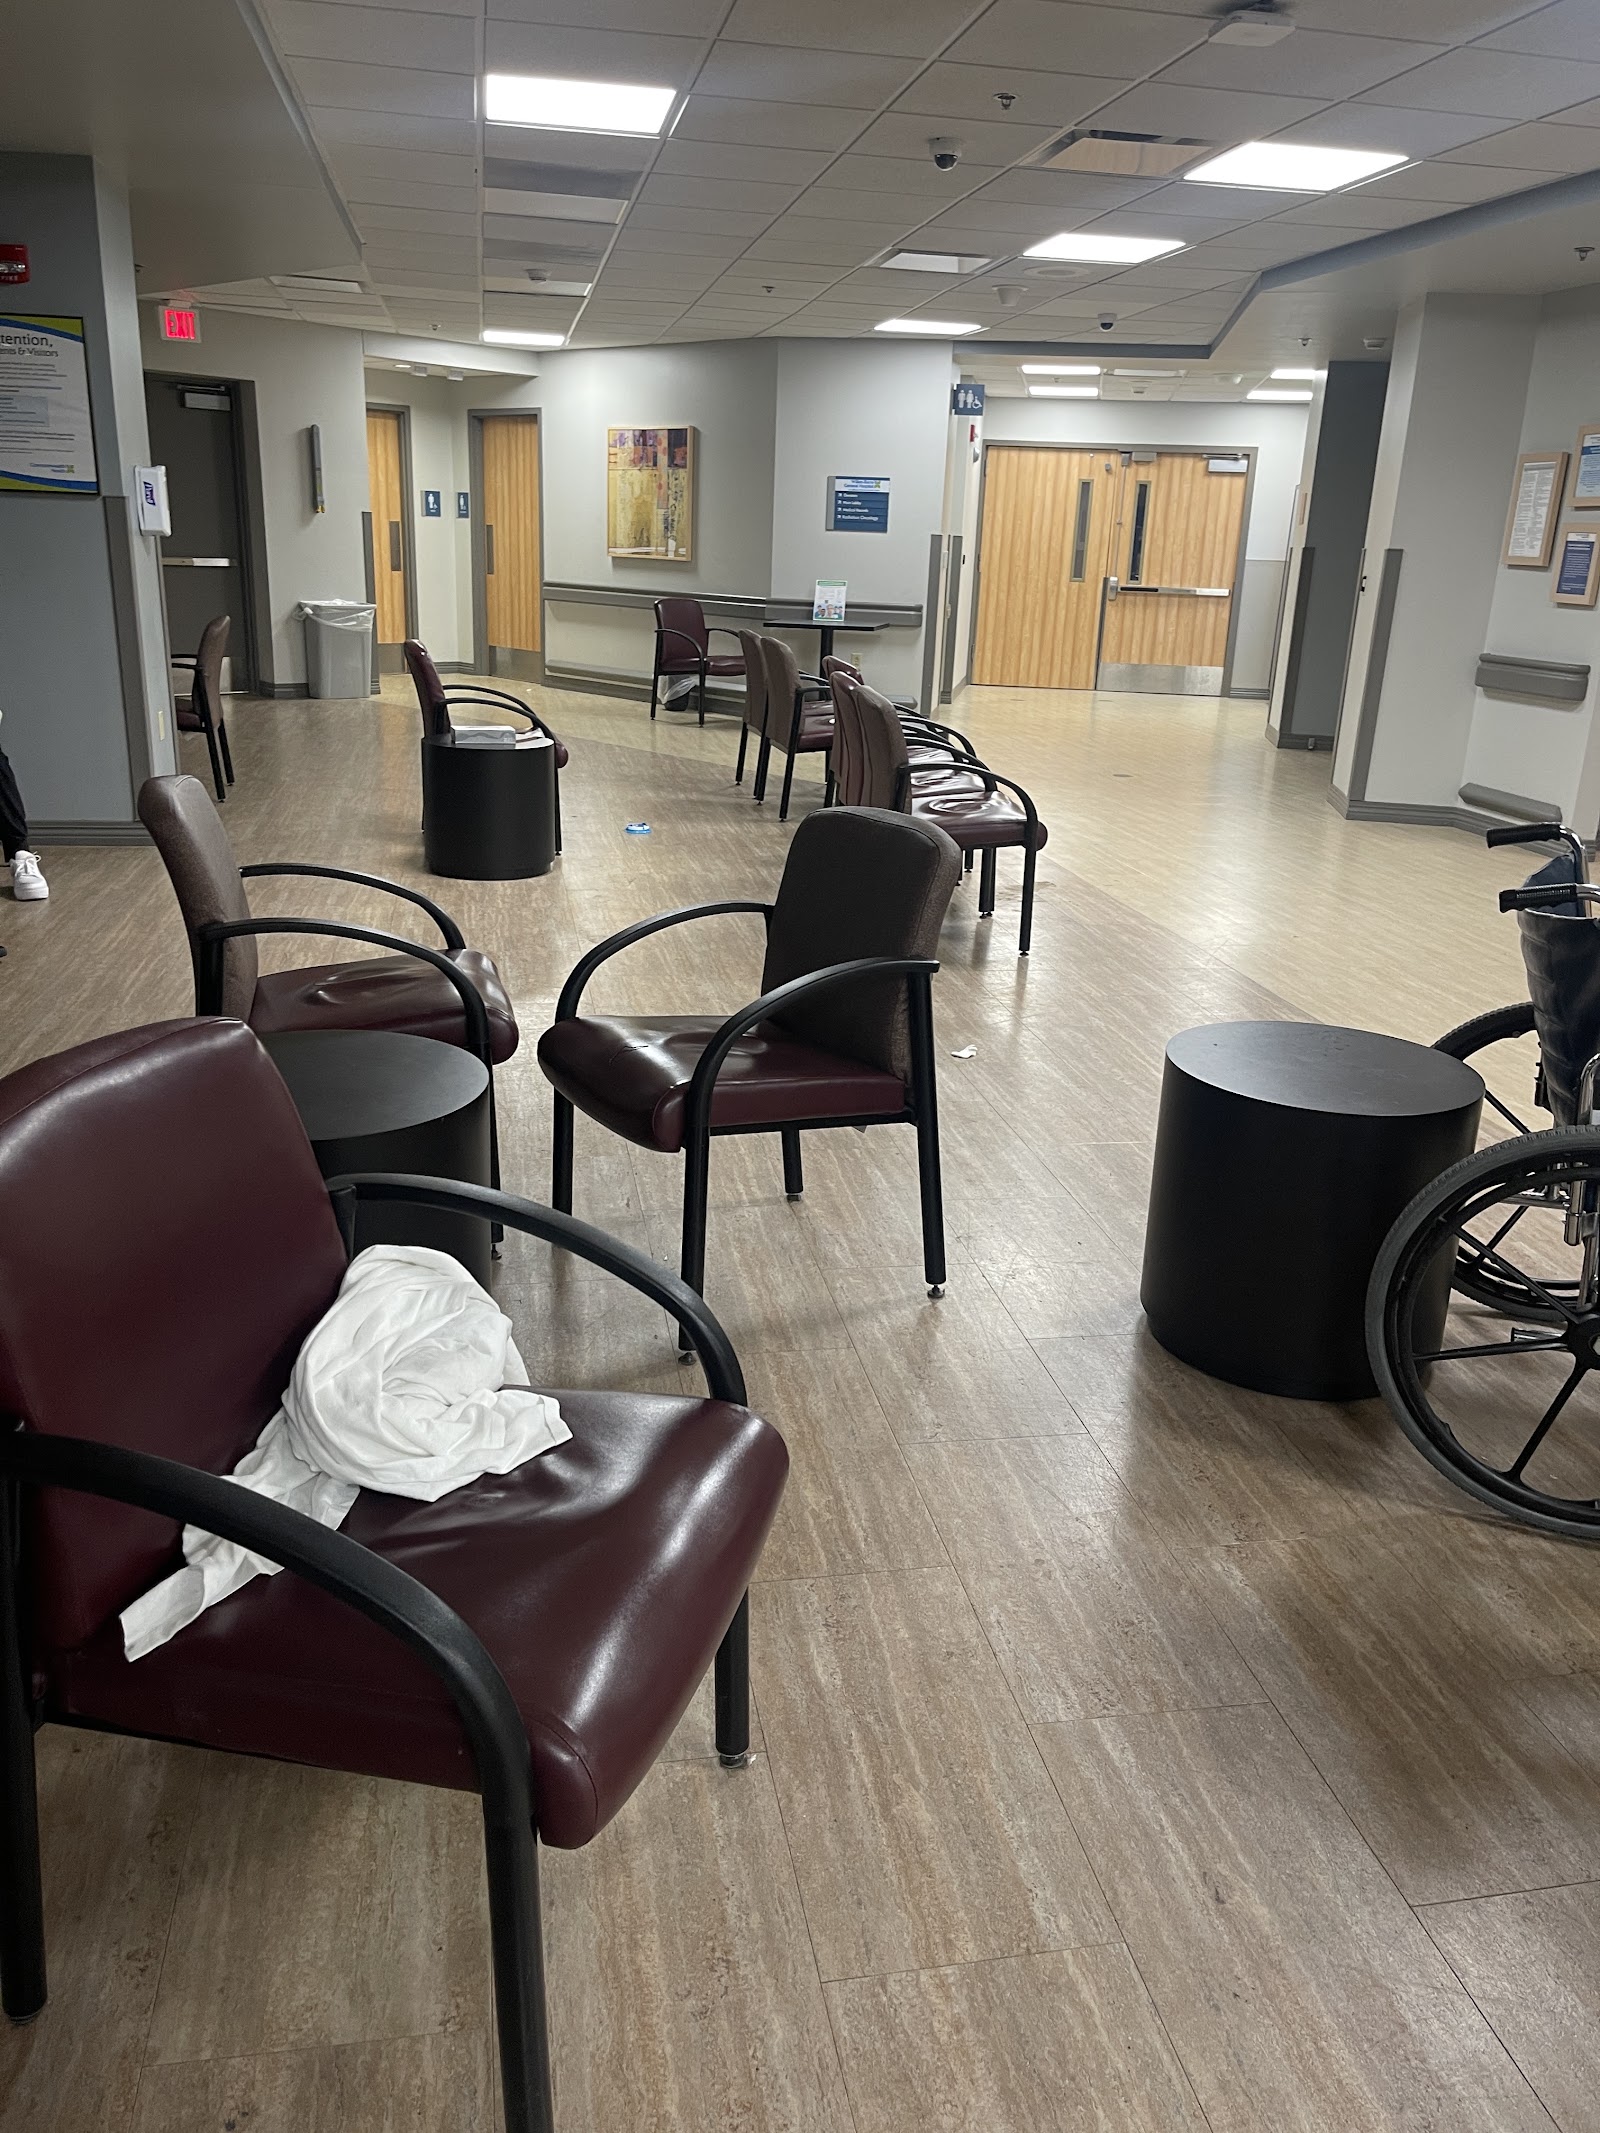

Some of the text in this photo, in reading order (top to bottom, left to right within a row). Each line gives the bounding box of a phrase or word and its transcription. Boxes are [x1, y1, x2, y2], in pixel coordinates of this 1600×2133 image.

[165, 309, 195, 339] EXIT
[18, 347, 25, 355] &
[28, 348, 59, 357] Visitors
